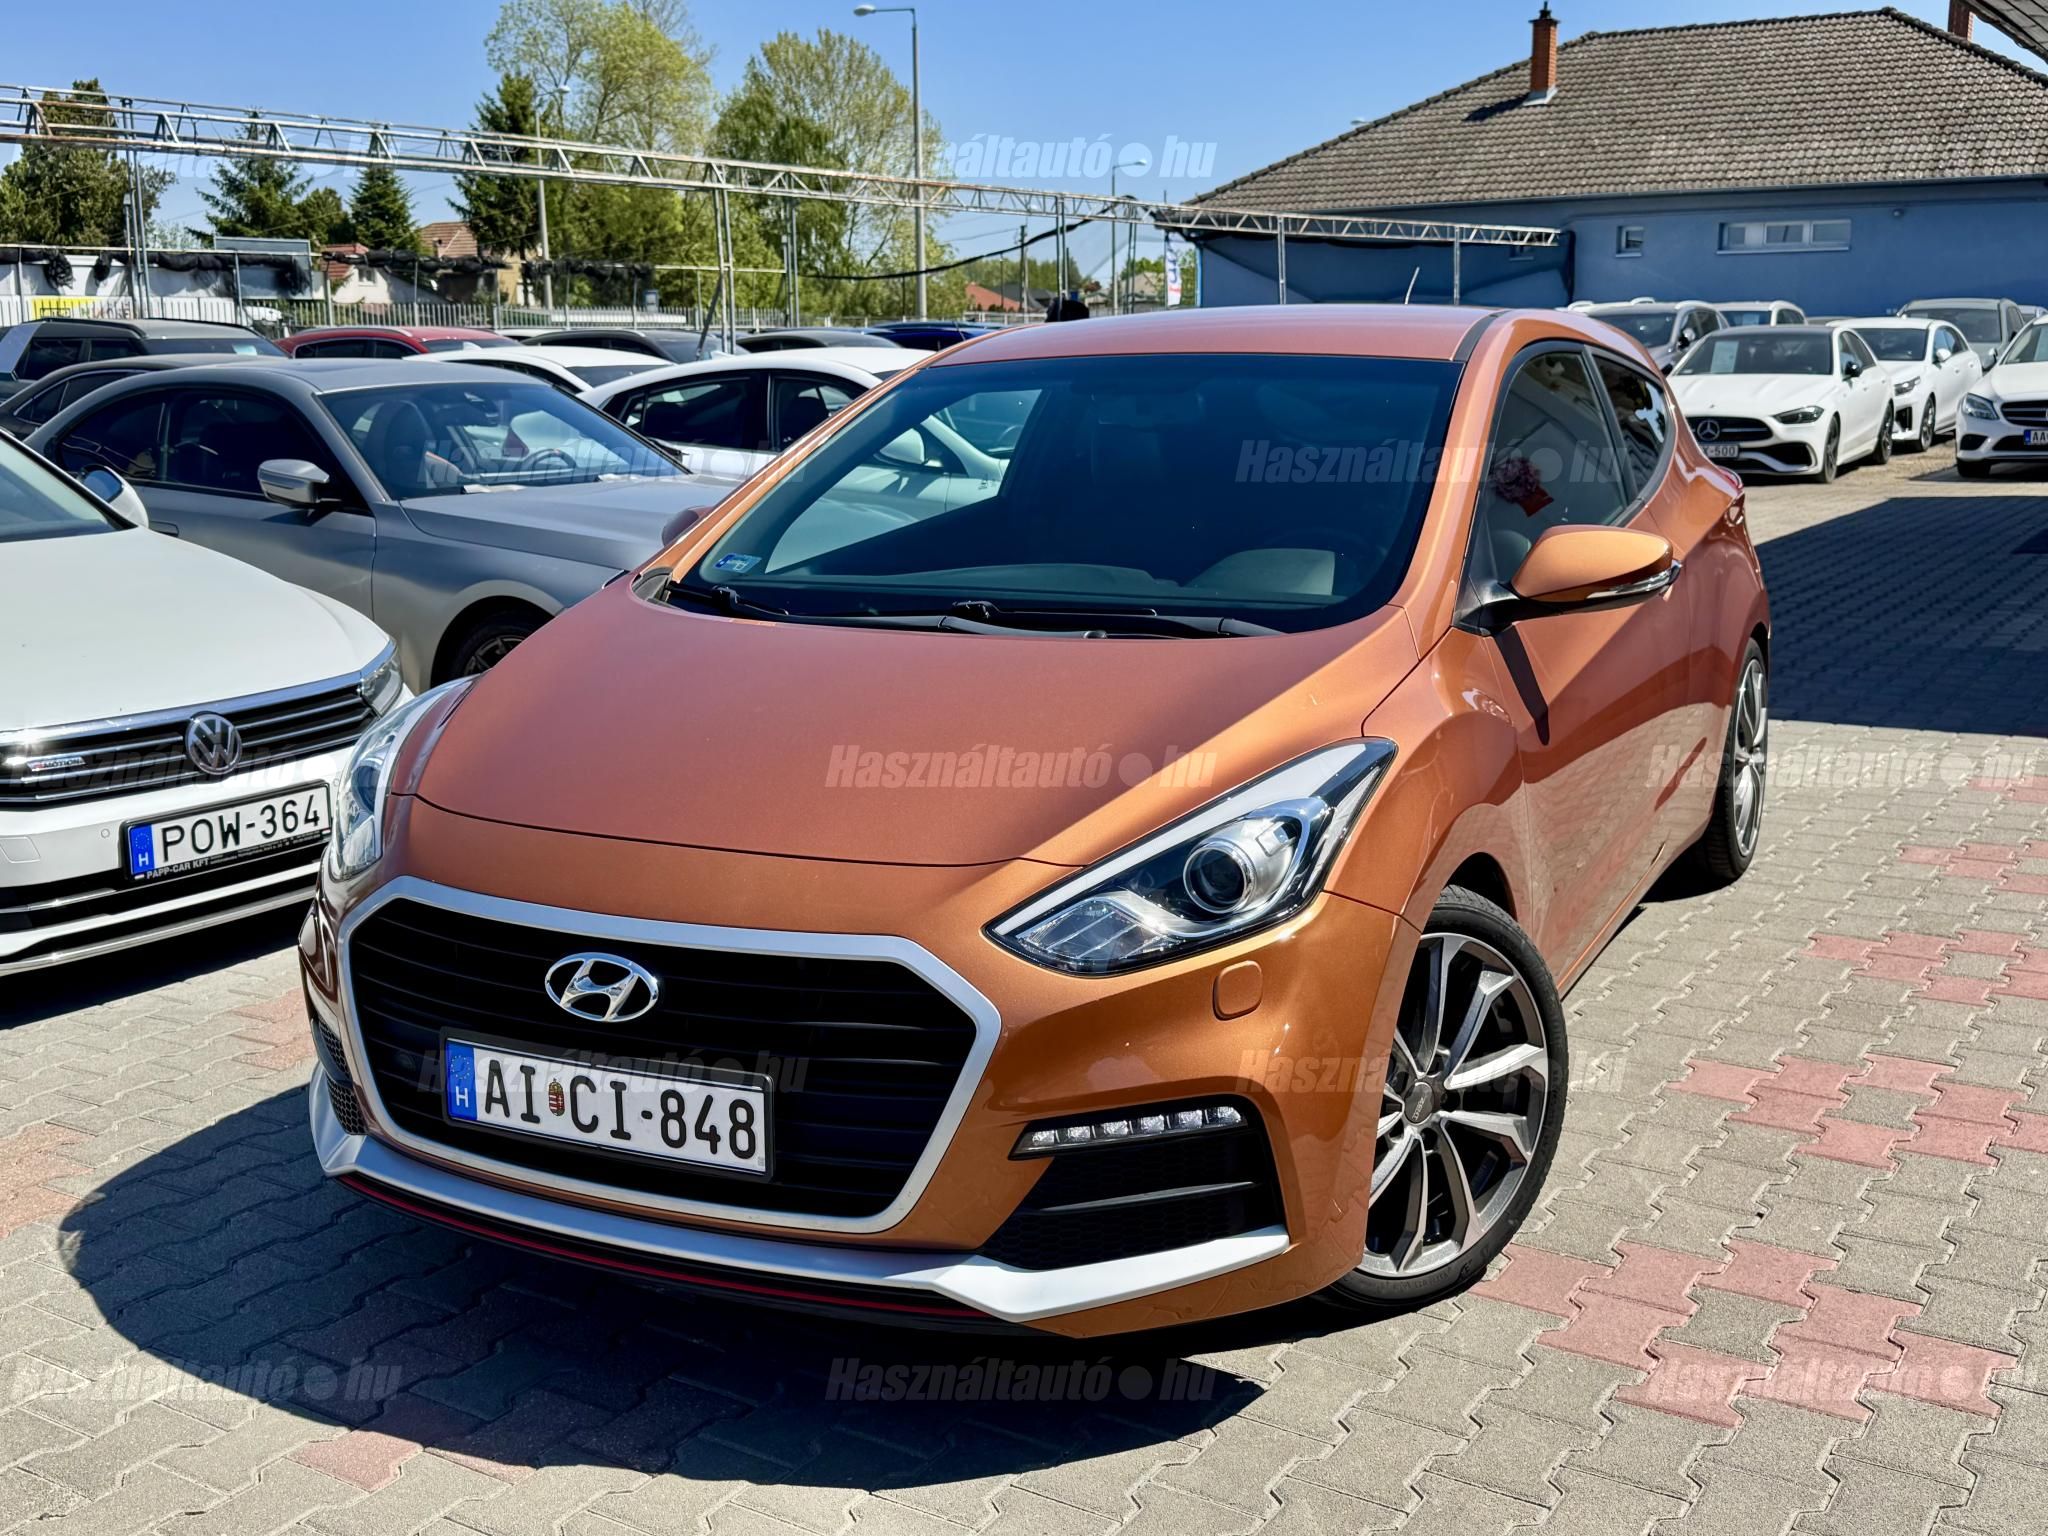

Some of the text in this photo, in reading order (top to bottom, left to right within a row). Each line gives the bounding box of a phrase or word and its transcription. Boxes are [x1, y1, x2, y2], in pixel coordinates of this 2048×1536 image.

[160, 794, 321, 863] POW-364
[138, 852, 149, 867] H
[146, 862, 192, 879] PAPP-CAR
[192, 858, 210, 869] KFT
[455, 1086, 469, 1108] H
